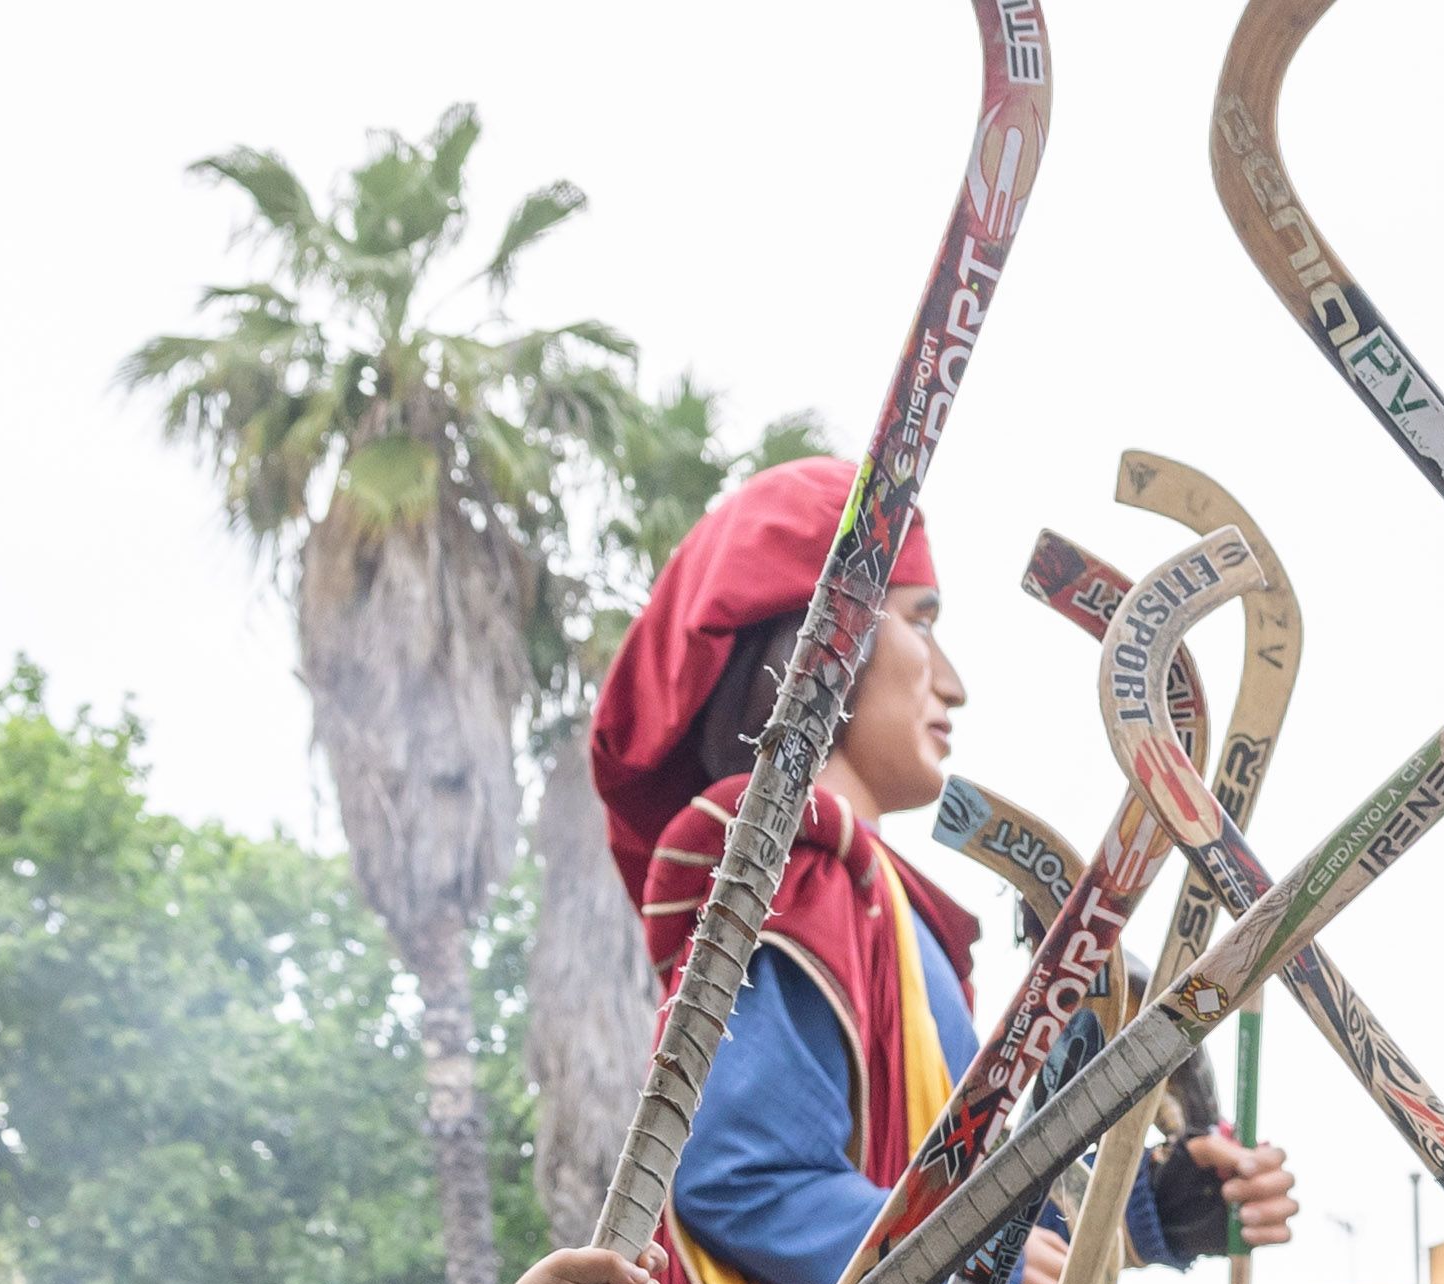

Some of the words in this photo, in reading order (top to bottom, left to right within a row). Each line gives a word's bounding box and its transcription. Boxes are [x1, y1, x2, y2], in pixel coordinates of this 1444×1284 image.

[899, 328, 939, 446] ETISPORT
[1112, 550, 1222, 728] ETISPORT
[1306, 788, 1403, 897] CERDANYOLA
[998, 961, 1054, 1061] ETISPORT
